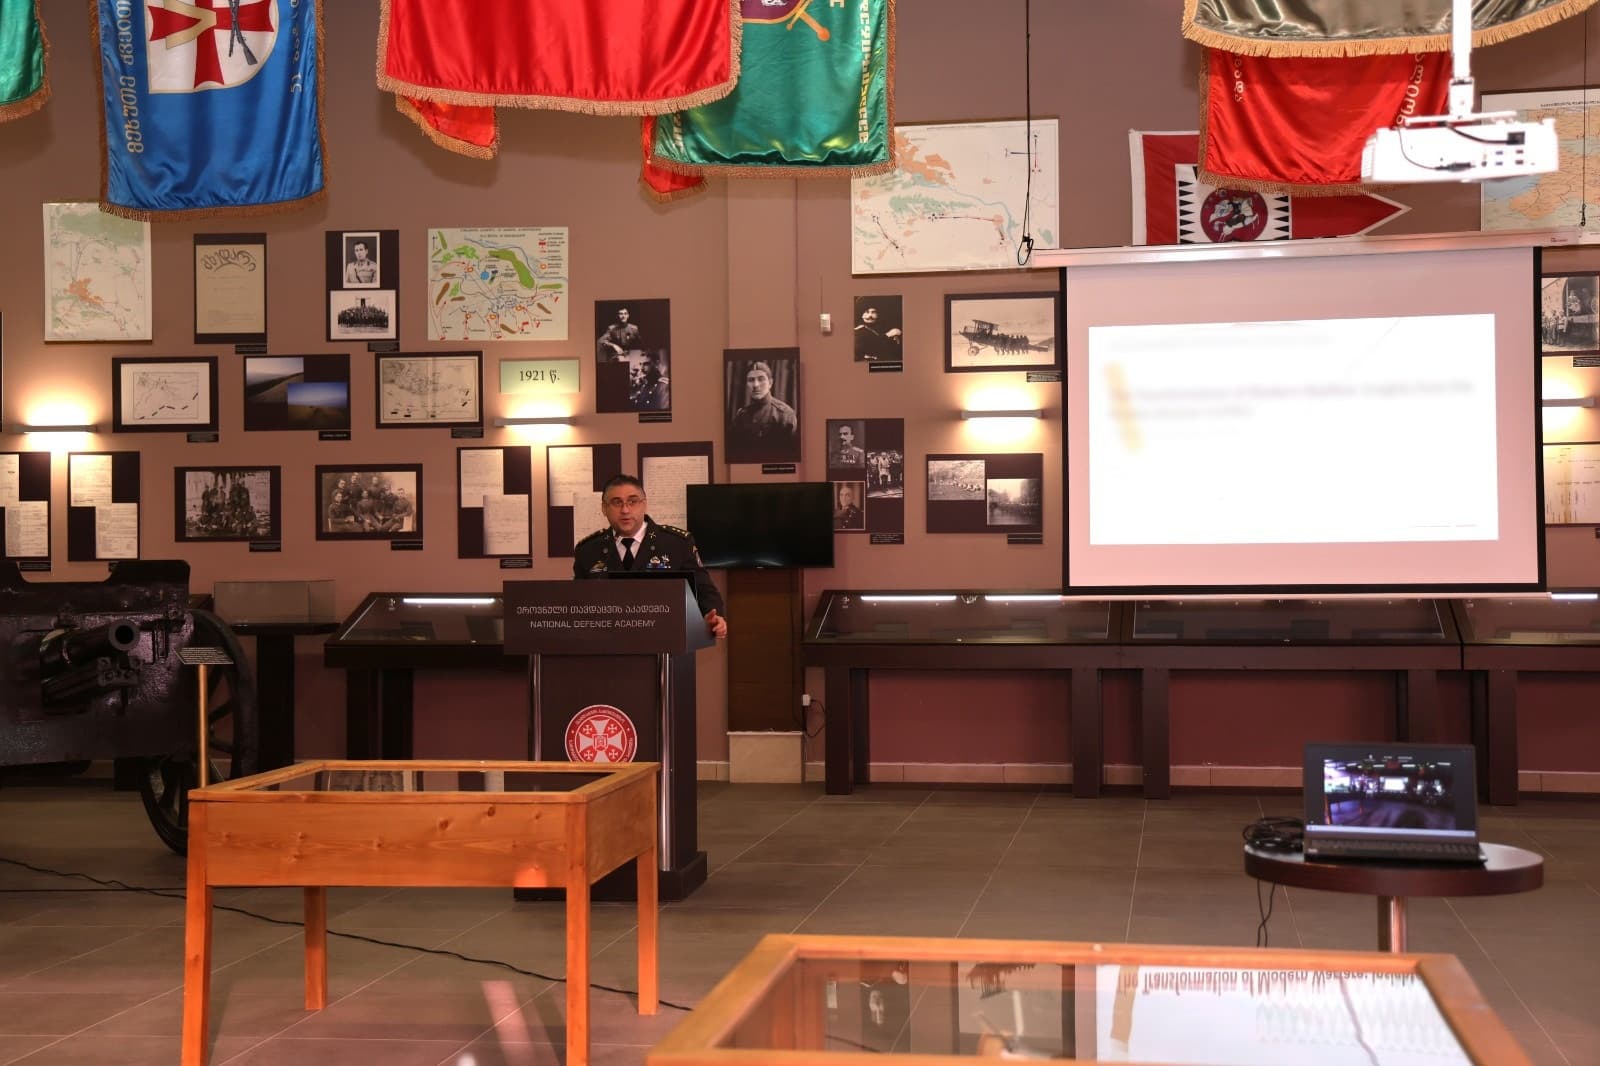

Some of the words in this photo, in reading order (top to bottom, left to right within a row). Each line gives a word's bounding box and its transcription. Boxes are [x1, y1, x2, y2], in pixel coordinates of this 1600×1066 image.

[519, 370, 545, 382] 1921
[530, 620, 571, 629] NATIONAL
[573, 620, 612, 628] DEFENCE
[614, 619, 656, 628] ACADEMY
